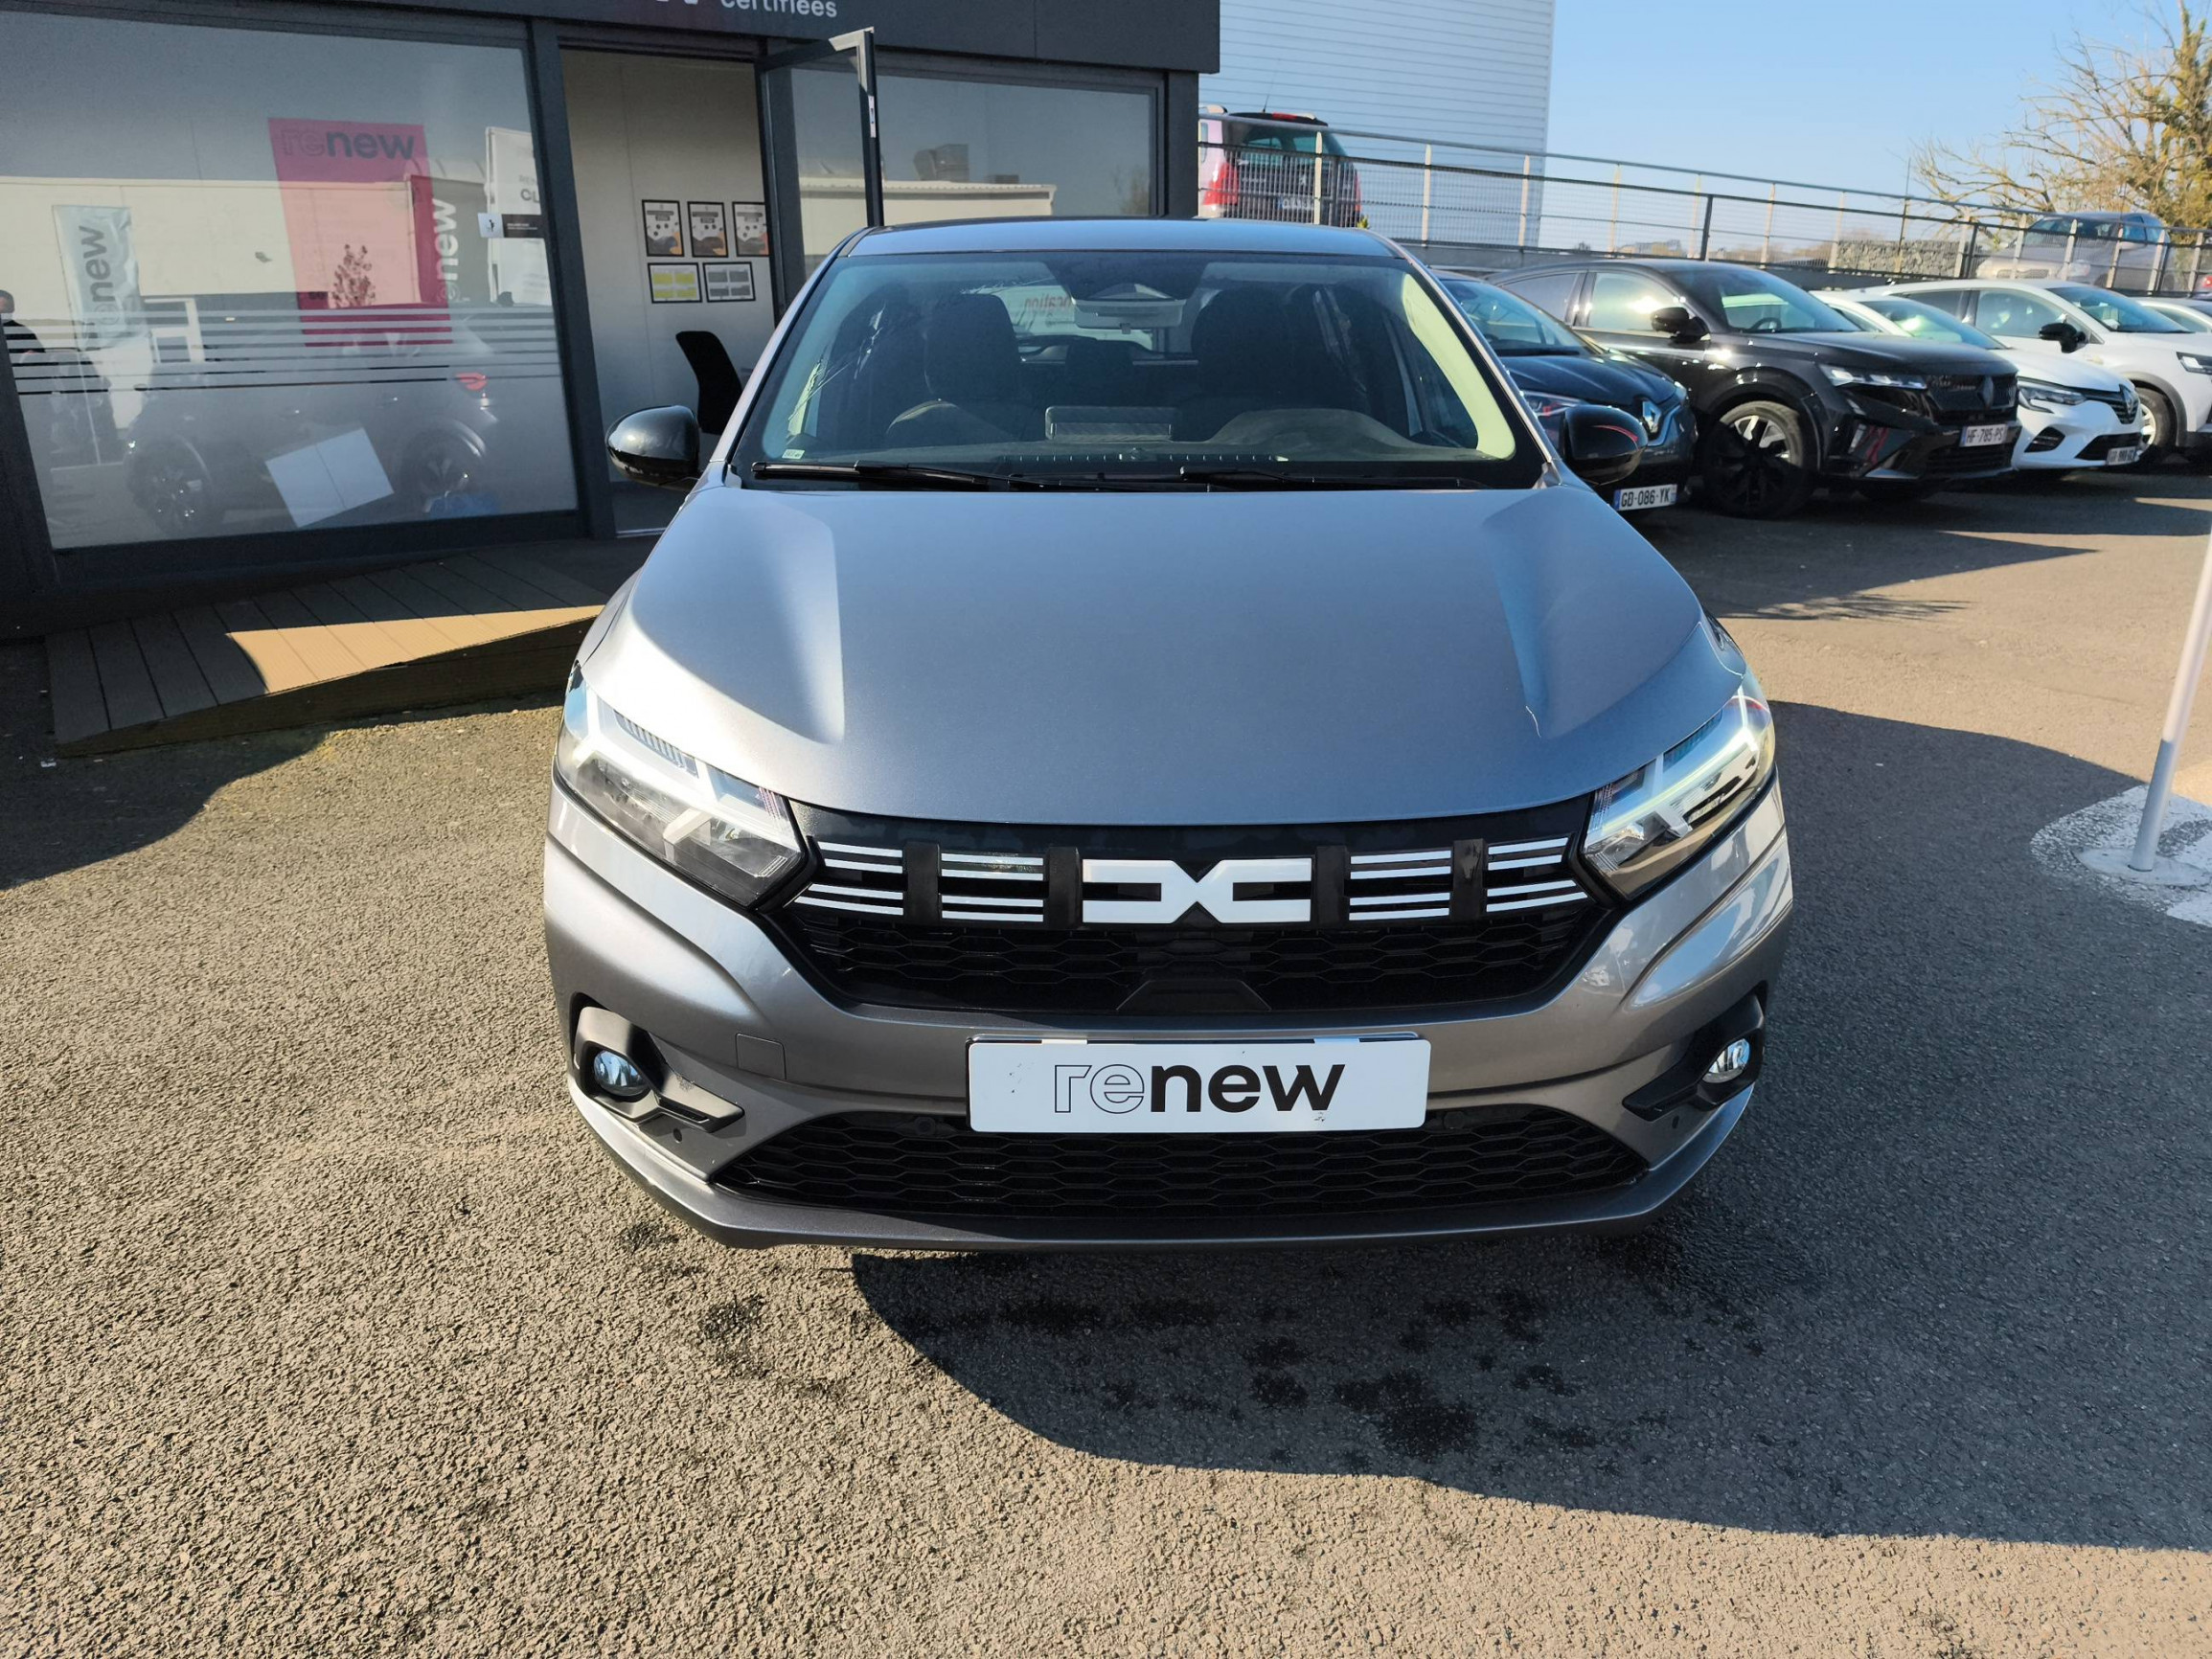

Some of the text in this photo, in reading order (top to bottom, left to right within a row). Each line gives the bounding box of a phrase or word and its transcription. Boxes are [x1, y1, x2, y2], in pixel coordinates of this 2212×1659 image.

[281, 128, 416, 161] renew
[431, 197, 460, 303] enew
[78, 224, 120, 328] enew
[1621, 488, 1671, 508] GD-086-YK
[1054, 1063, 1346, 1114] renew
